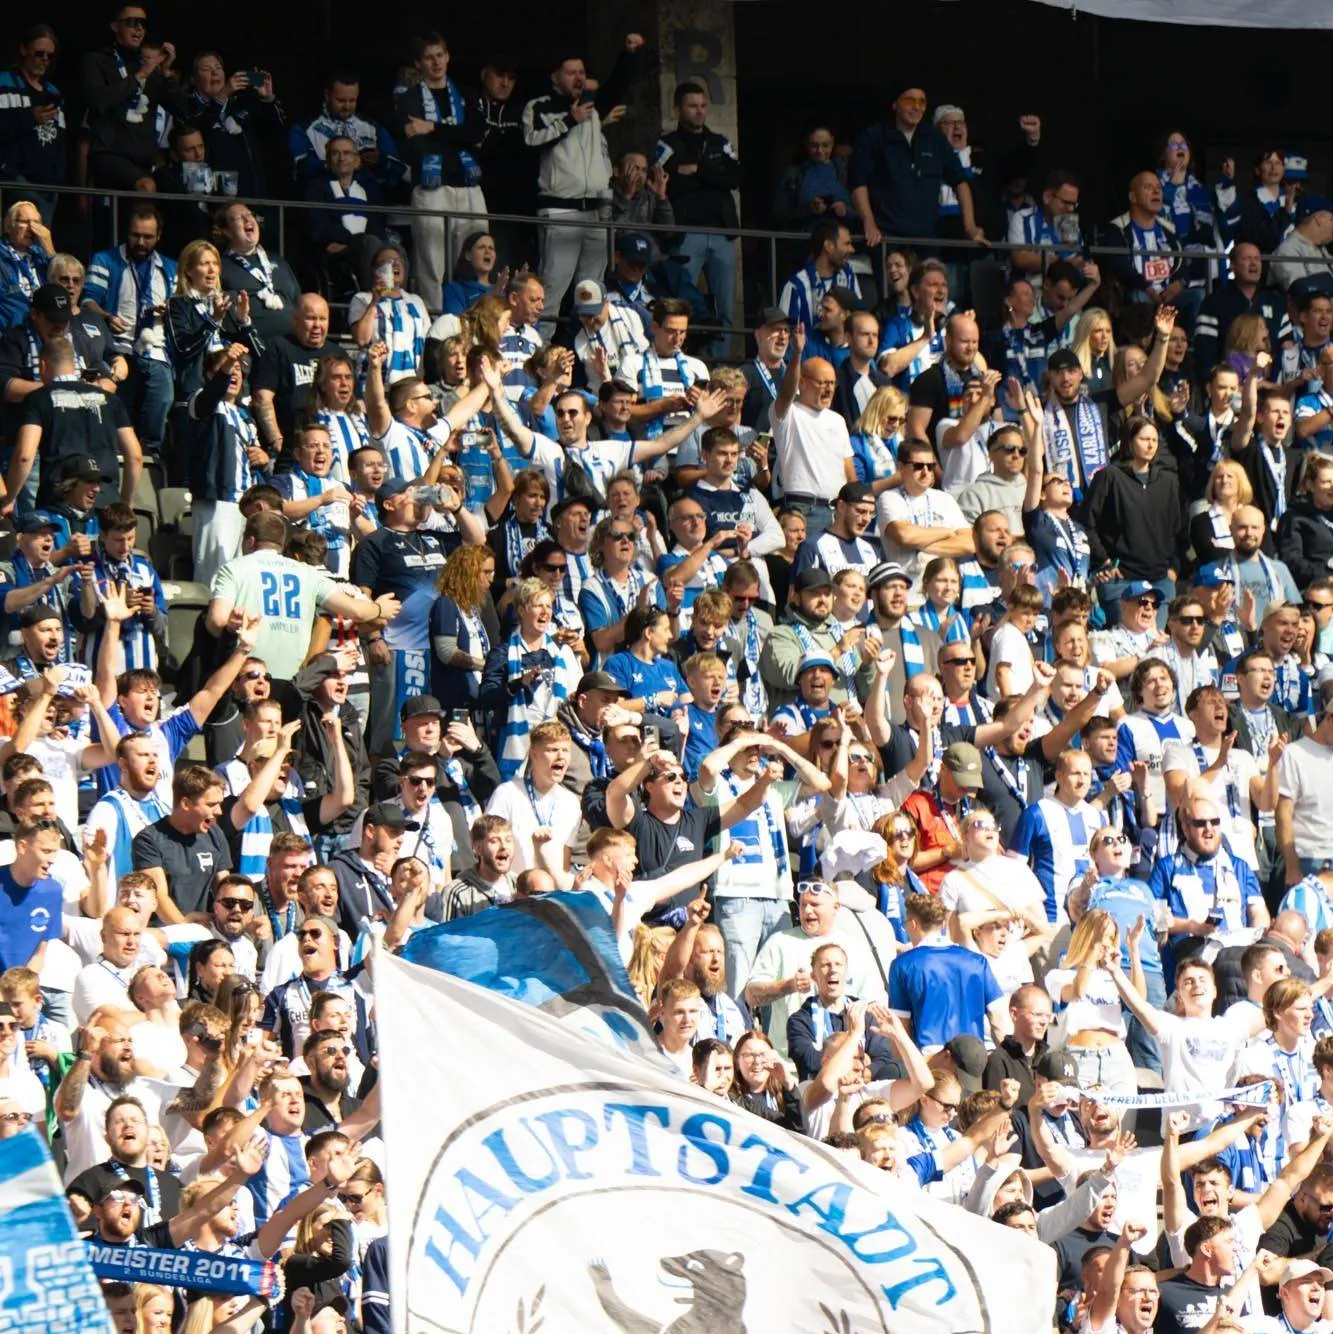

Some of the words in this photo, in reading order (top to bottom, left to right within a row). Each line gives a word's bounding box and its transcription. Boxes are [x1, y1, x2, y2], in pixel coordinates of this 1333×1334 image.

[261, 571, 302, 619] 22
[424, 1102, 957, 1310] HAUPTSTADT
[88, 1245, 188, 1275] MEISTER
[196, 1257, 252, 1282] 2011
[140, 1270, 213, 1286] BUNDESLIGA
